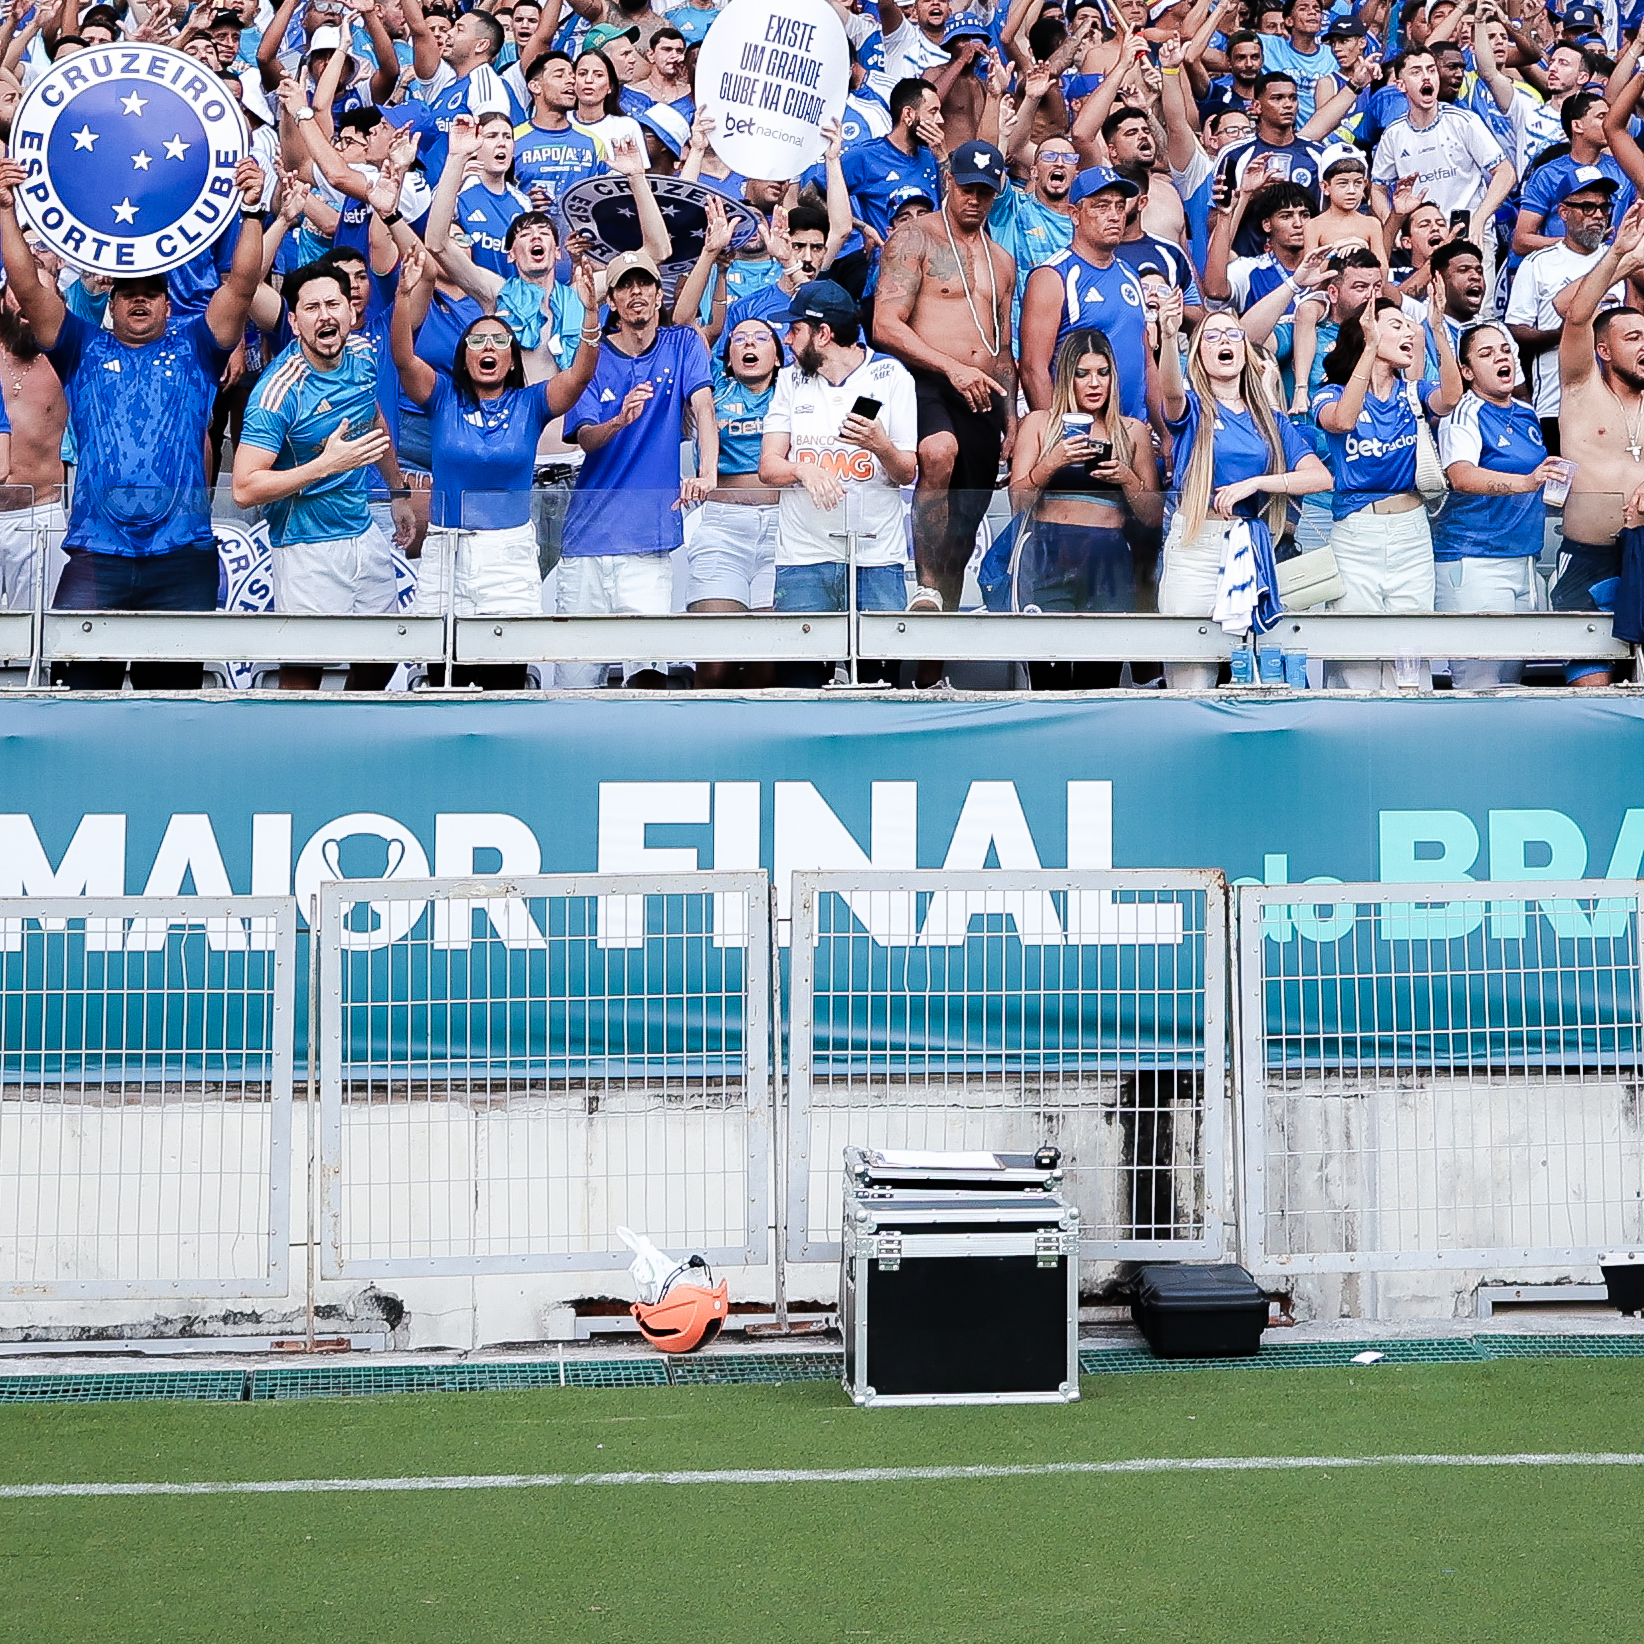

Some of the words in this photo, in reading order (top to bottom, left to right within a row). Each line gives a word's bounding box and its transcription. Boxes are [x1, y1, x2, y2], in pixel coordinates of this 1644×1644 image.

[764, 13, 818, 53] EXISTE
[40, 52, 226, 123] CRUZEIRO
[740, 41, 767, 74] UM
[765, 48, 824, 91] GRANDE
[719, 71, 760, 107] CLUBE
[758, 80, 782, 113] NA
[782, 87, 827, 127] CIDADE
[19, 129, 136, 266] ESPORTE
[154, 149, 238, 258] CLUBE
[796, 435, 836, 446] BANCO
[597, 779, 1184, 950] FINAL
